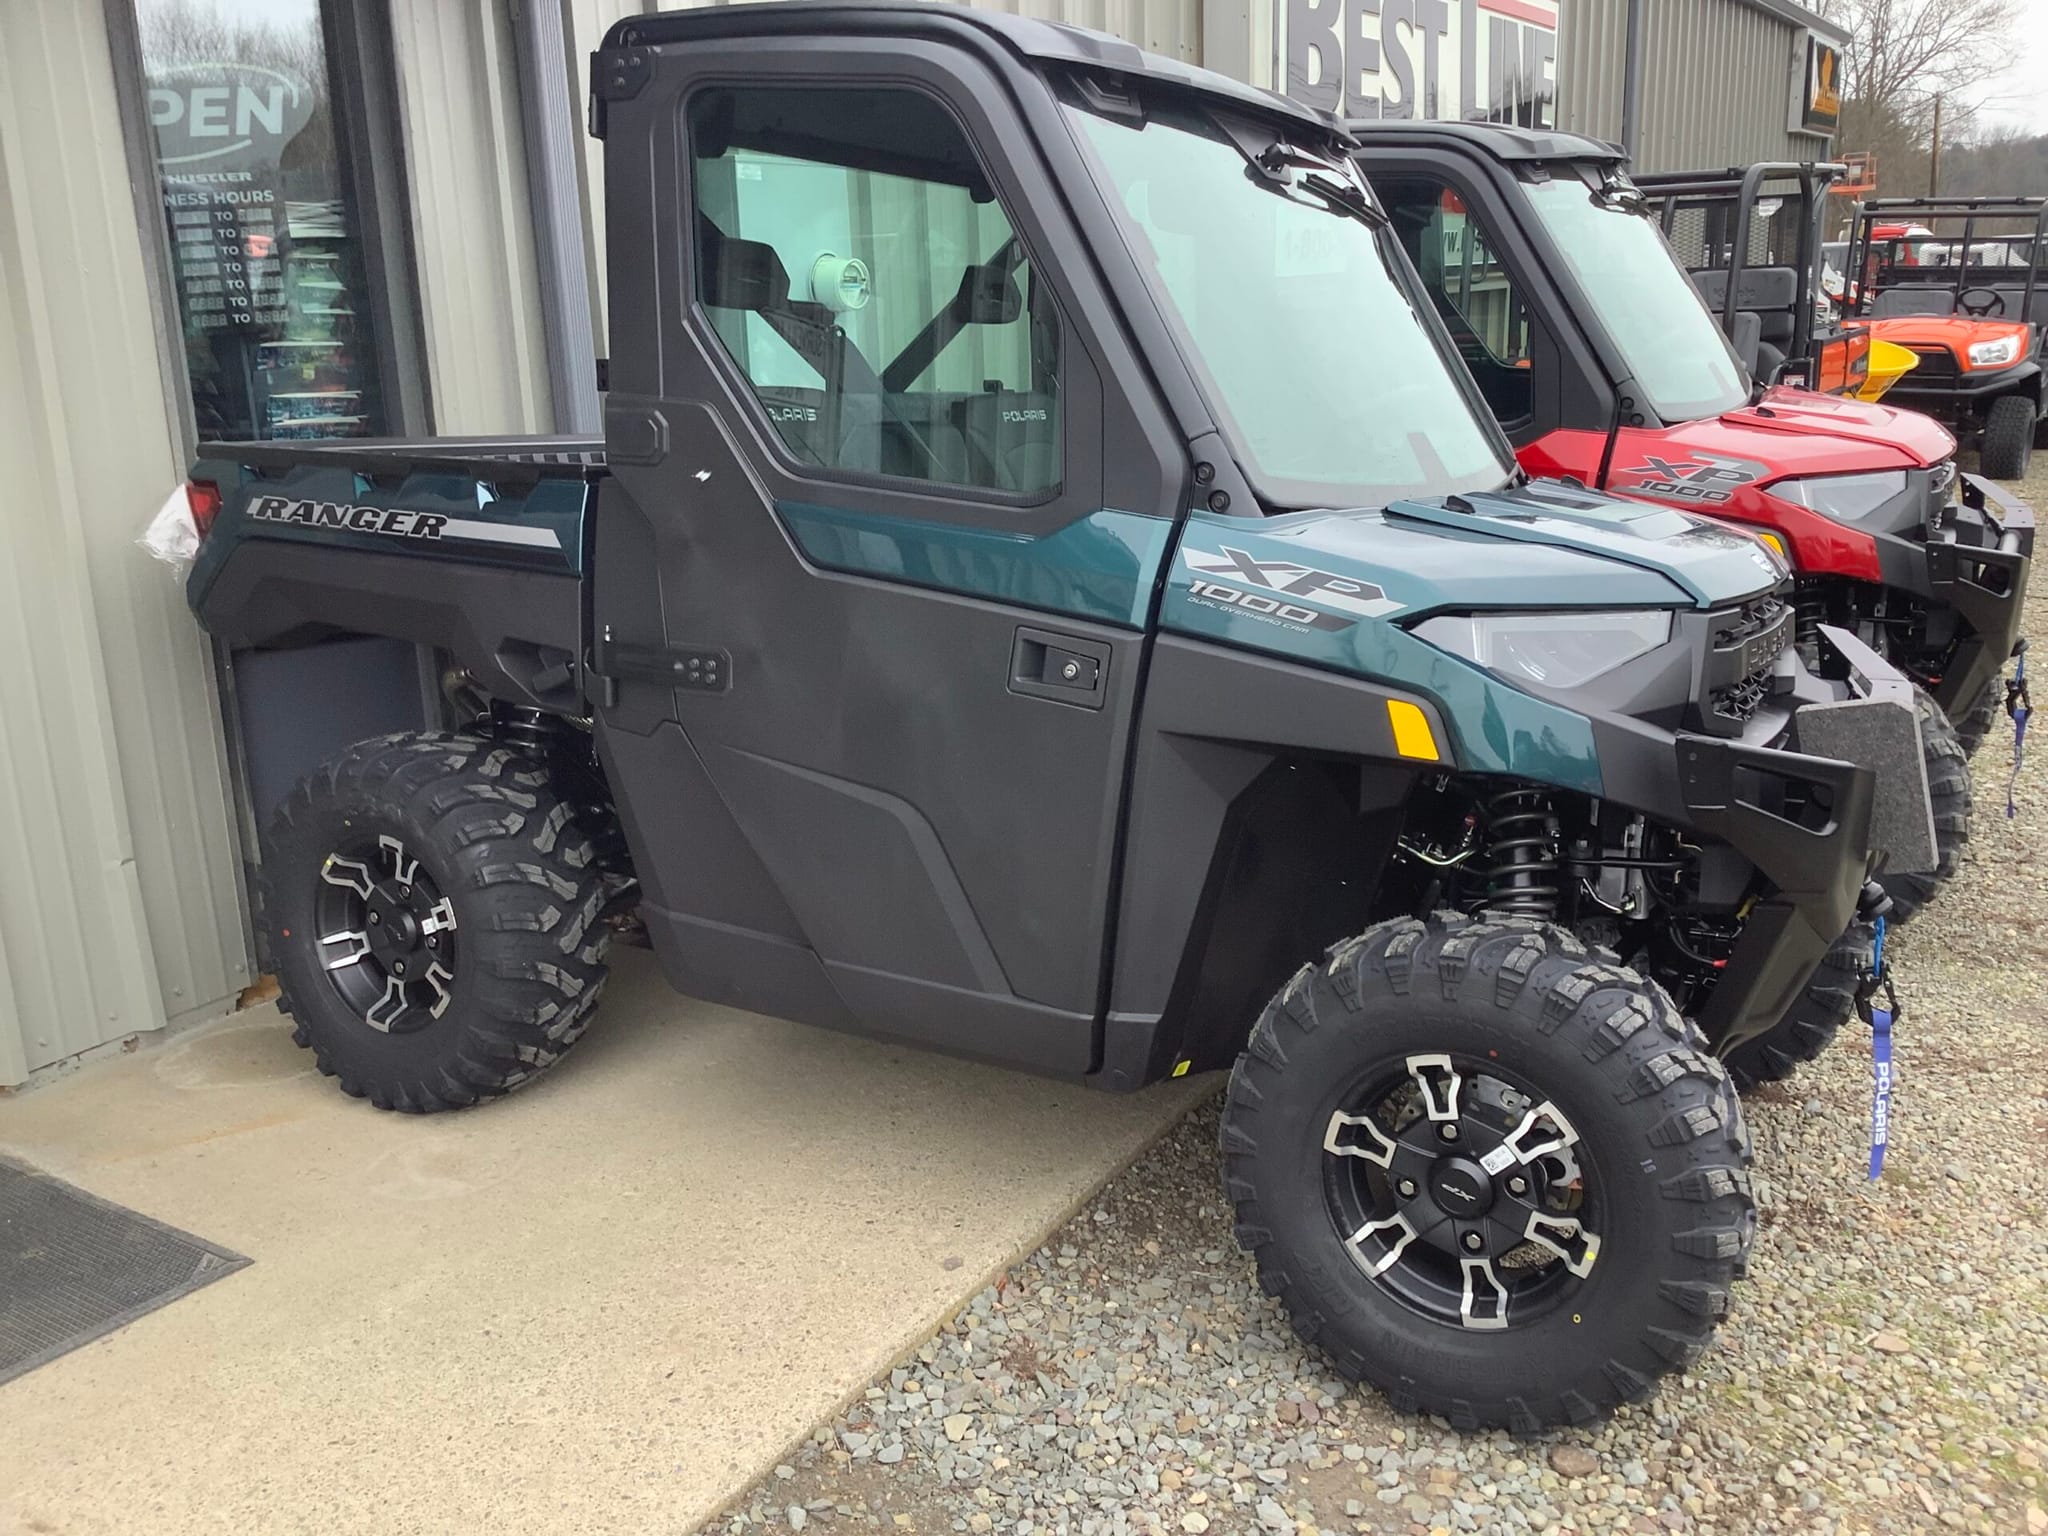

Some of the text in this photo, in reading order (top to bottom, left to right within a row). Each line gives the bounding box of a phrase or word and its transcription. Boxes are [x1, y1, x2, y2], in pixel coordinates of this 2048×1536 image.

[1287, 0, 1556, 131] BEST LINE
[148, 85, 284, 137] PEN
[164, 189, 275, 207] NESS HOURS
[214, 211, 233, 221] TO
[217, 228, 236, 238] TO
[220, 245, 239, 255] TO
[223, 262, 242, 272] TO
[226, 279, 245, 289] TO
[229, 296, 248, 306] TO
[232, 313, 251, 323] TO
[1002, 409, 1047, 423] POLARIS
[1616, 455, 1757, 485] XP
[1639, 479, 1734, 502] 1000
[252, 495, 449, 540] RANGER
[1192, 545, 1388, 602] XP
[1188, 580, 1319, 624] 1000
[1187, 596, 1311, 634] DUAL OVERHEAD CAM
[1874, 1062, 1890, 1146] POLARIS
